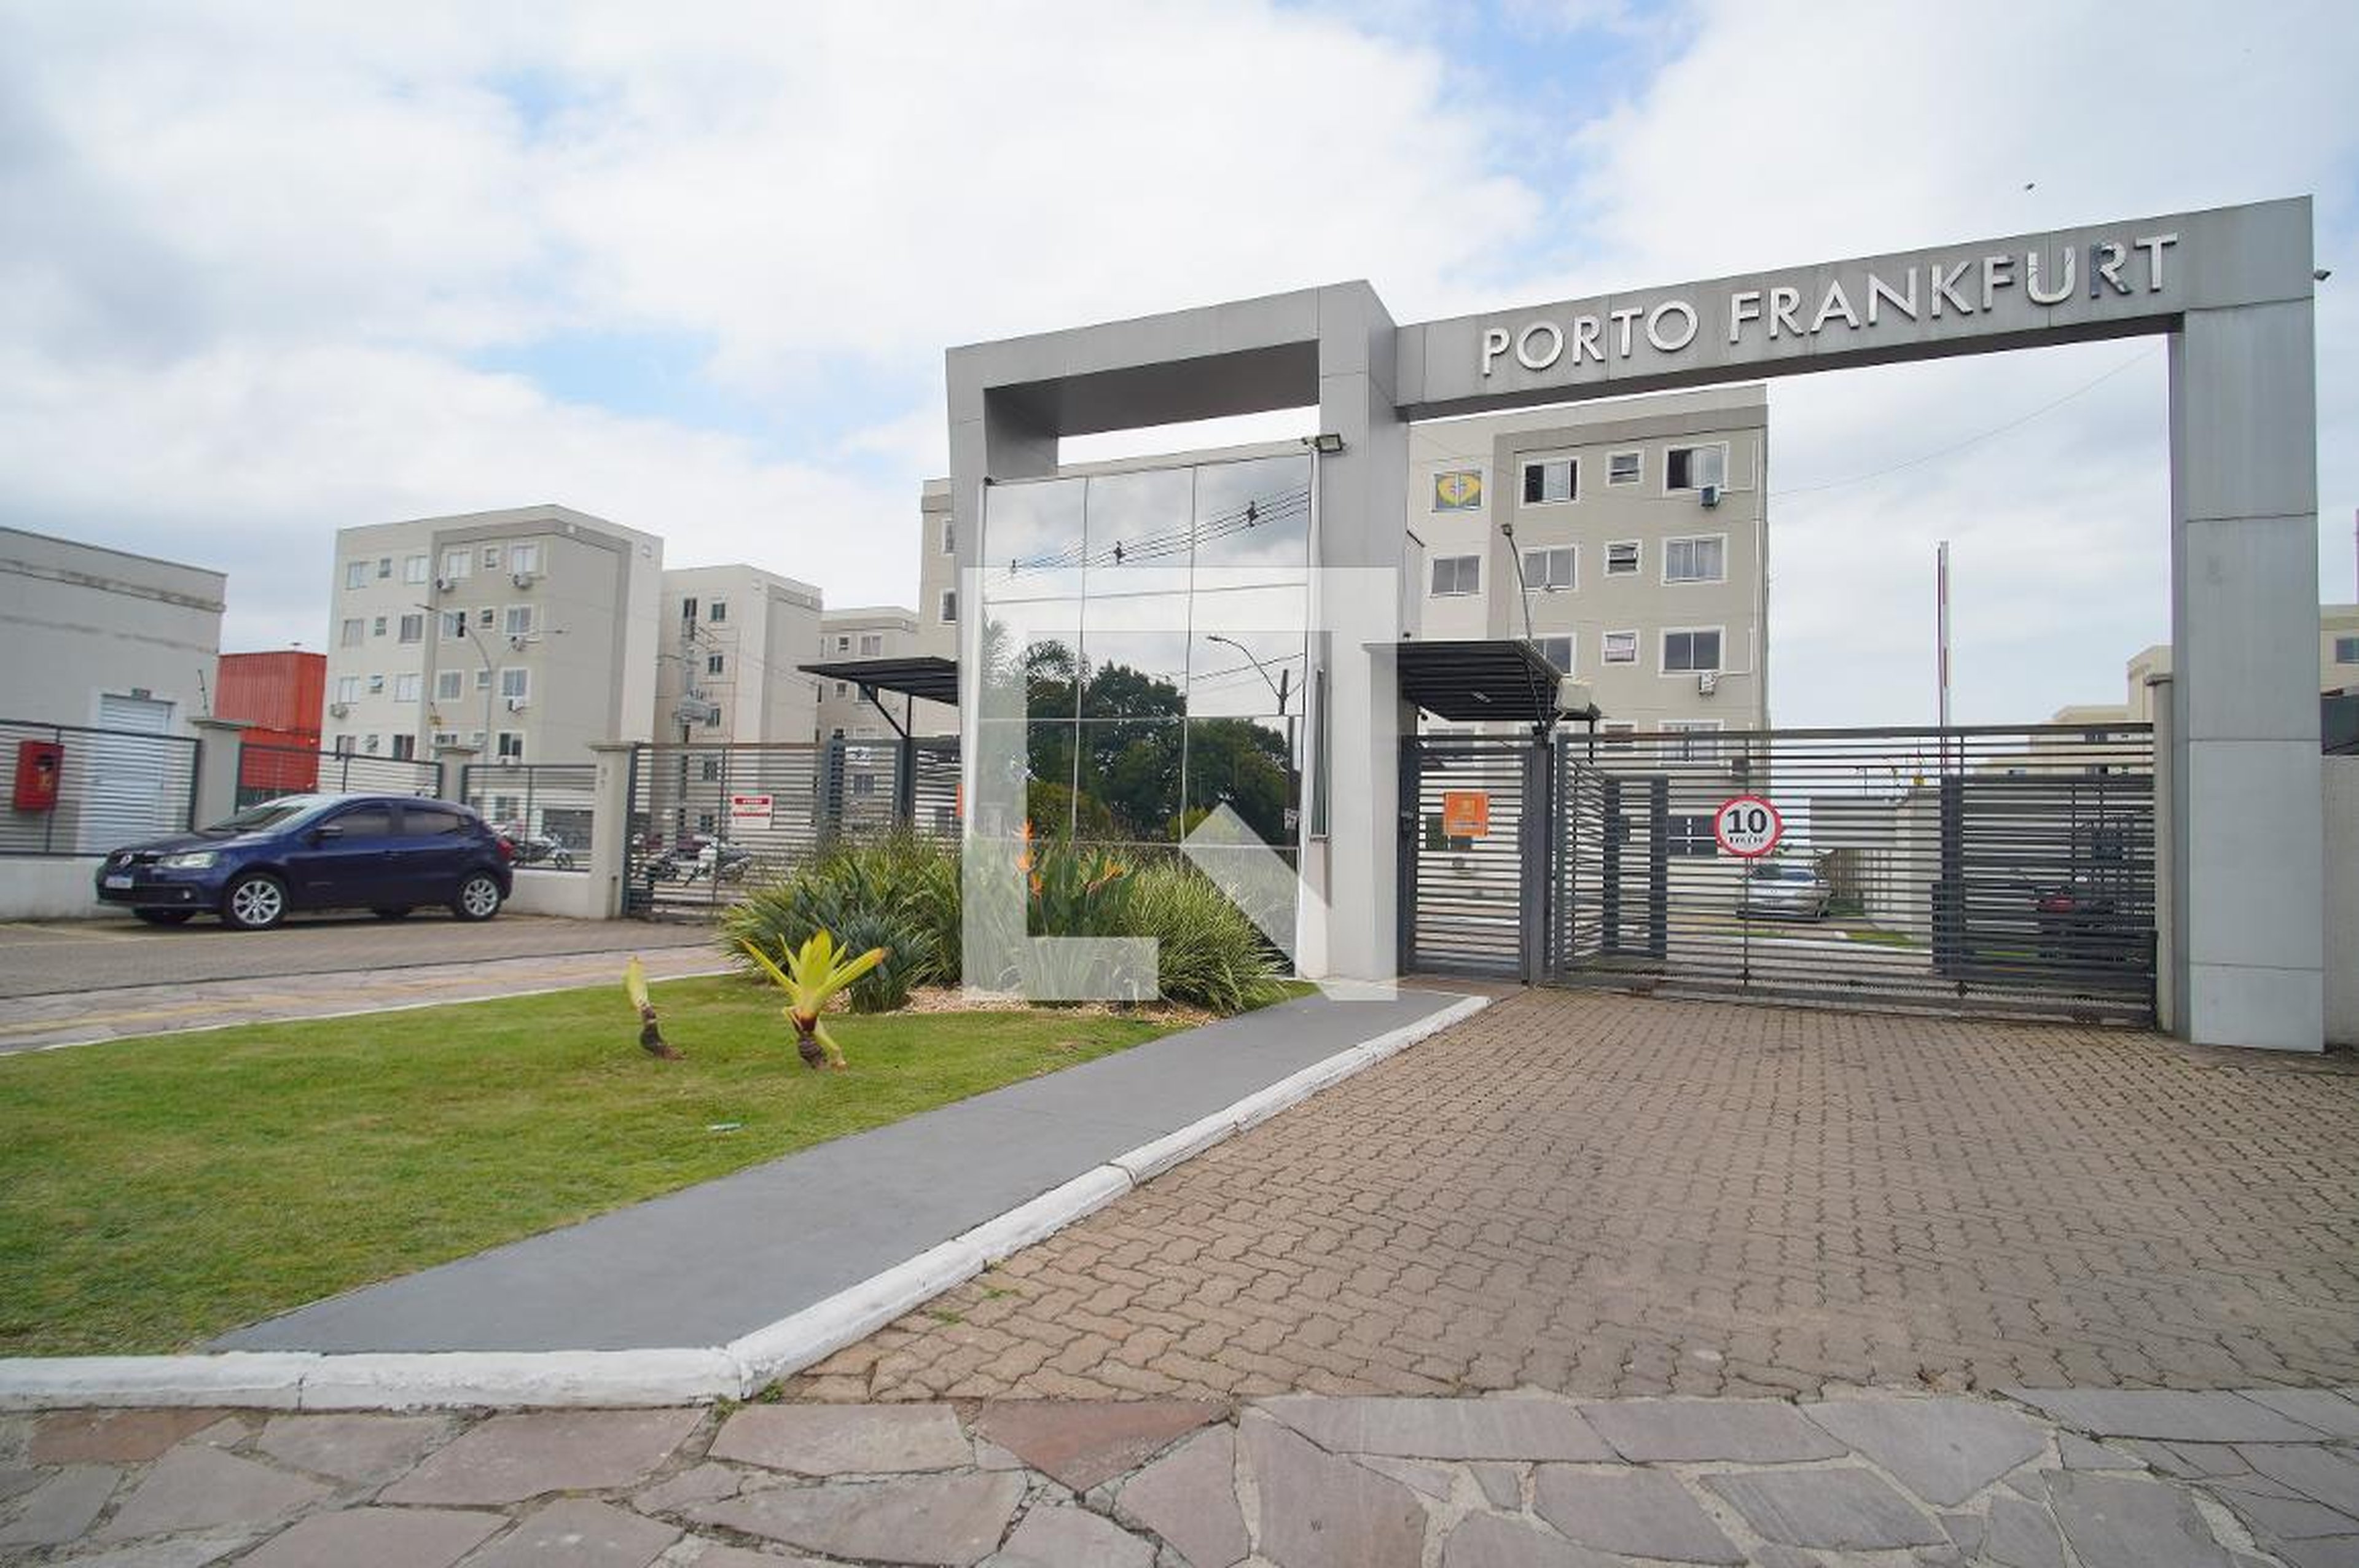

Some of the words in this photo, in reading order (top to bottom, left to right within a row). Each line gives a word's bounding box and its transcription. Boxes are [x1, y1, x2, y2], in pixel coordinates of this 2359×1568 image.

[1482, 298, 1699, 377] PORTO
[1728, 233, 2178, 344] FRANKFURT
[1727, 809, 1767, 833] 10
